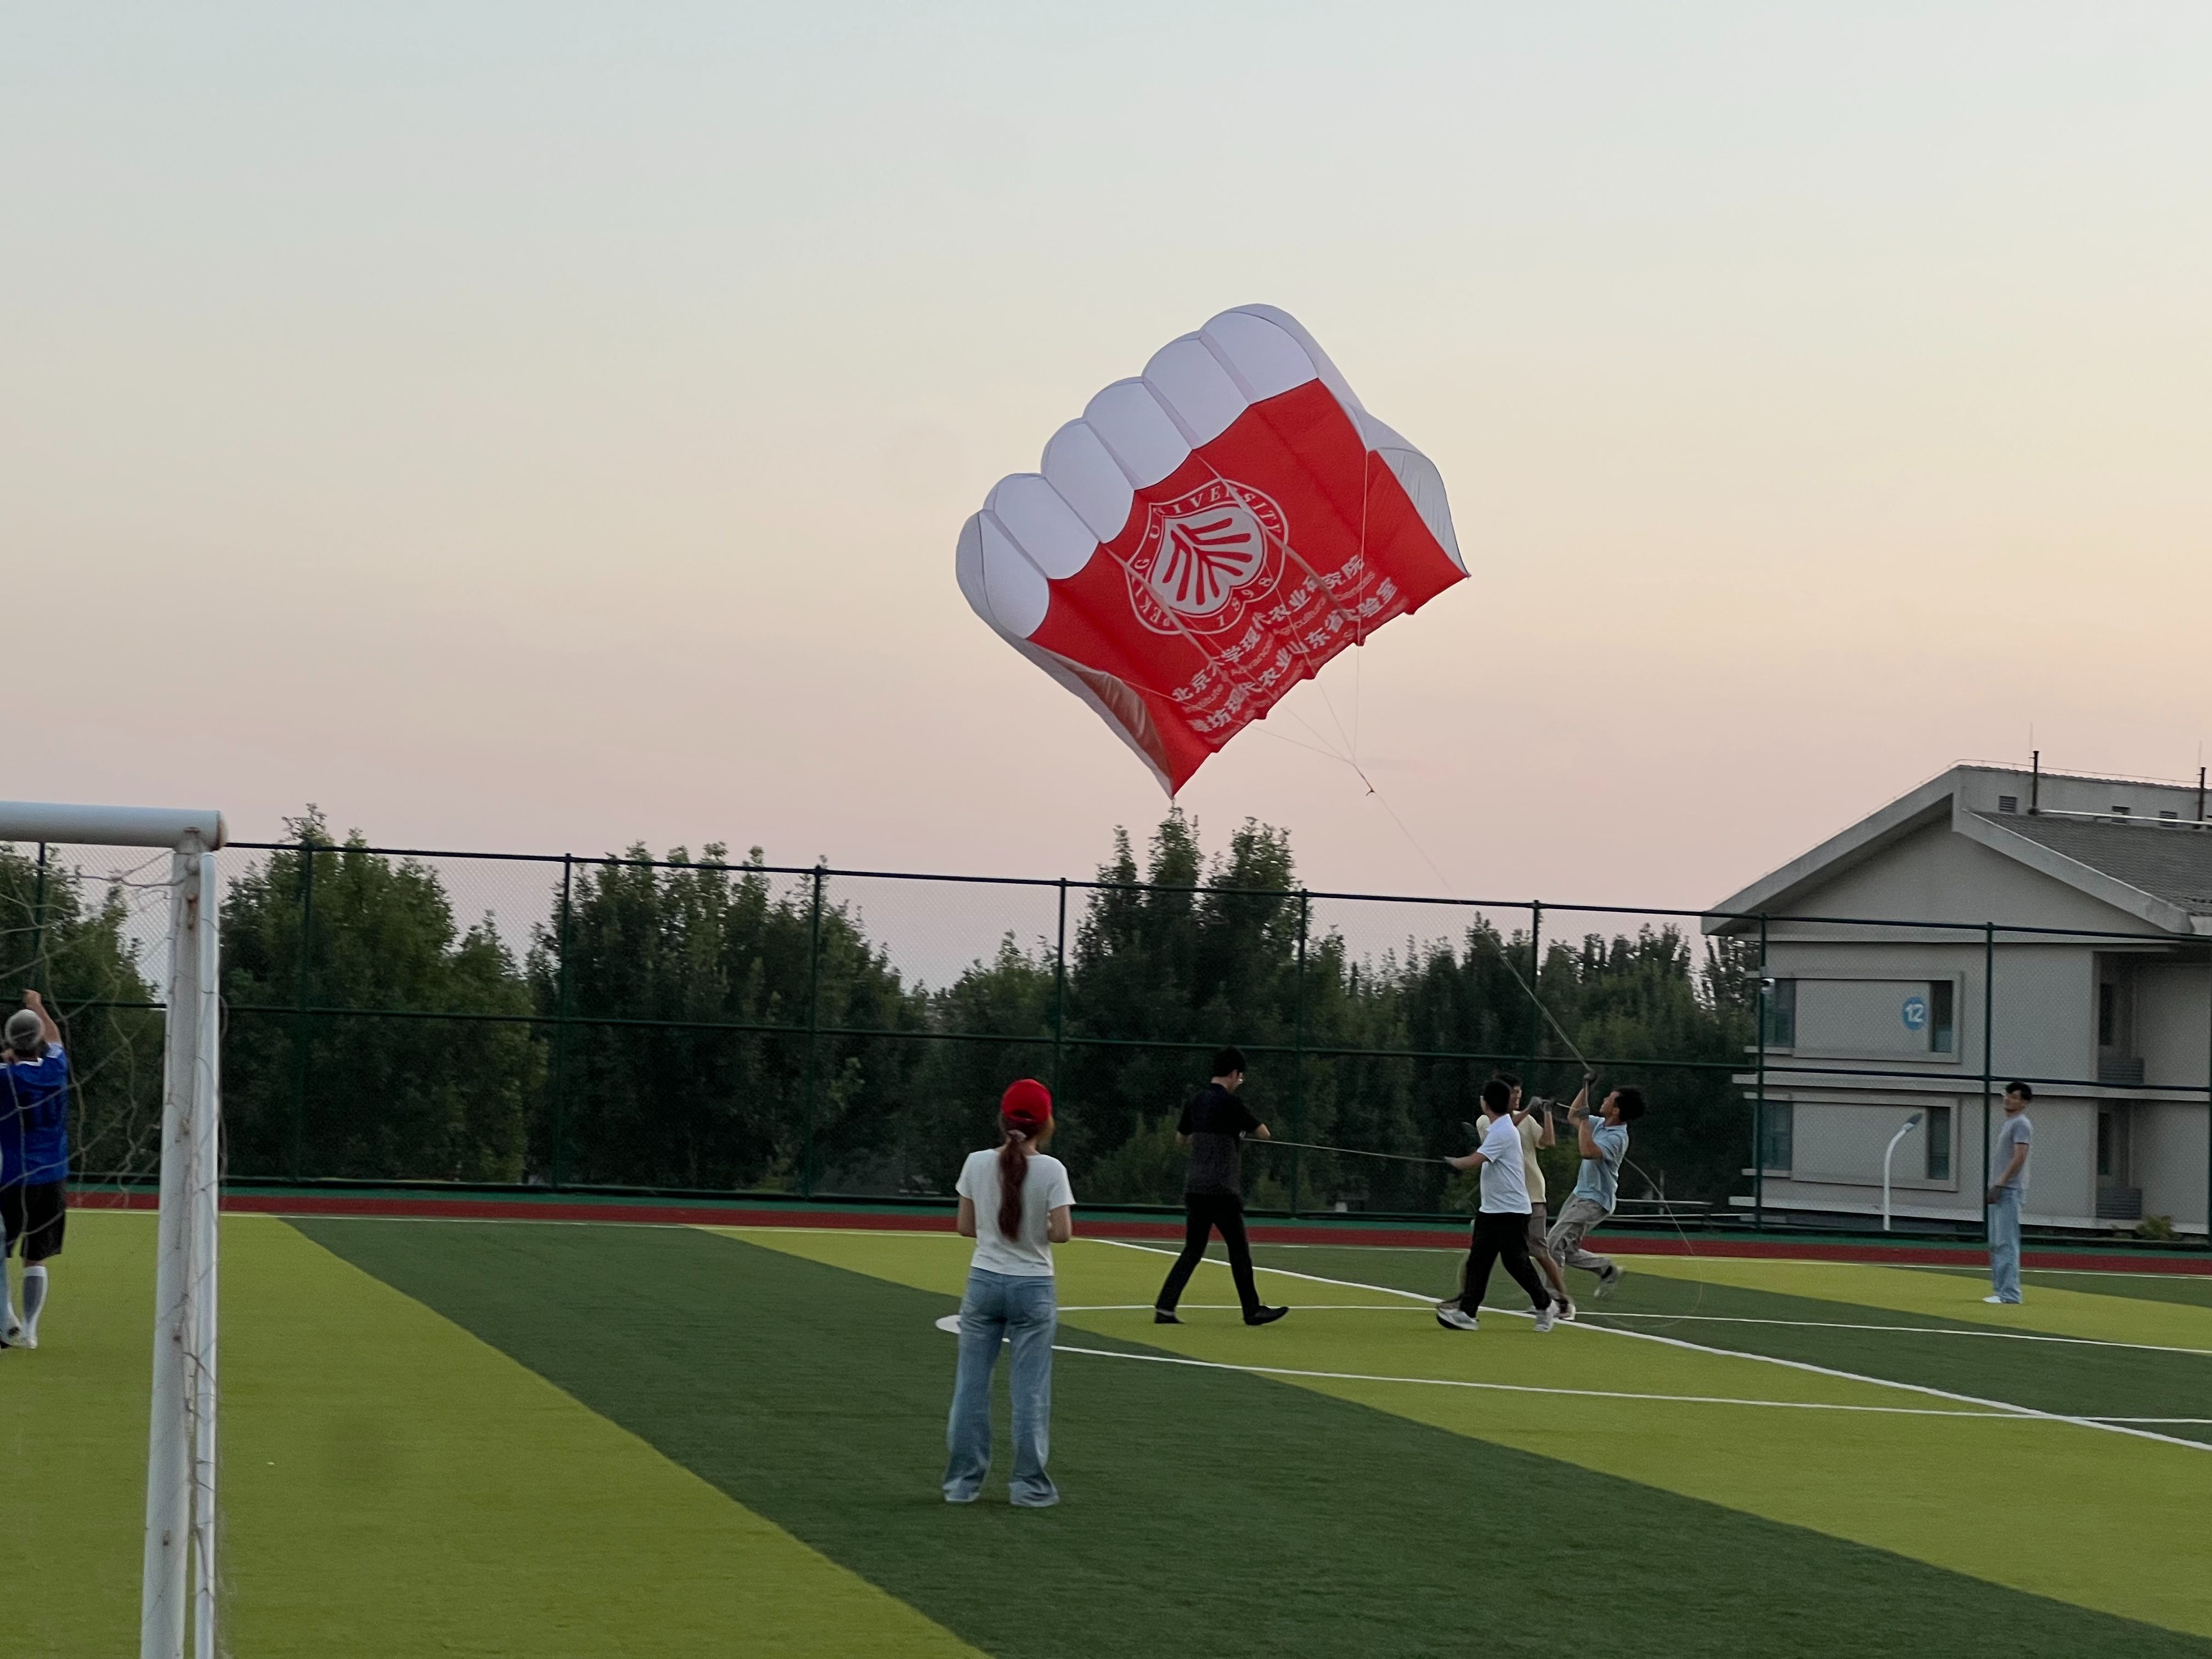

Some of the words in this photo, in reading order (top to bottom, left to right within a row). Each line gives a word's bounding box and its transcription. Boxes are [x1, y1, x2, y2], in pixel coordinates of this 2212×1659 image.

[1131, 558, 1172, 627] PEKIG
[1216, 577, 1273, 627] 1898
[1905, 1003, 1923, 1023] 12
